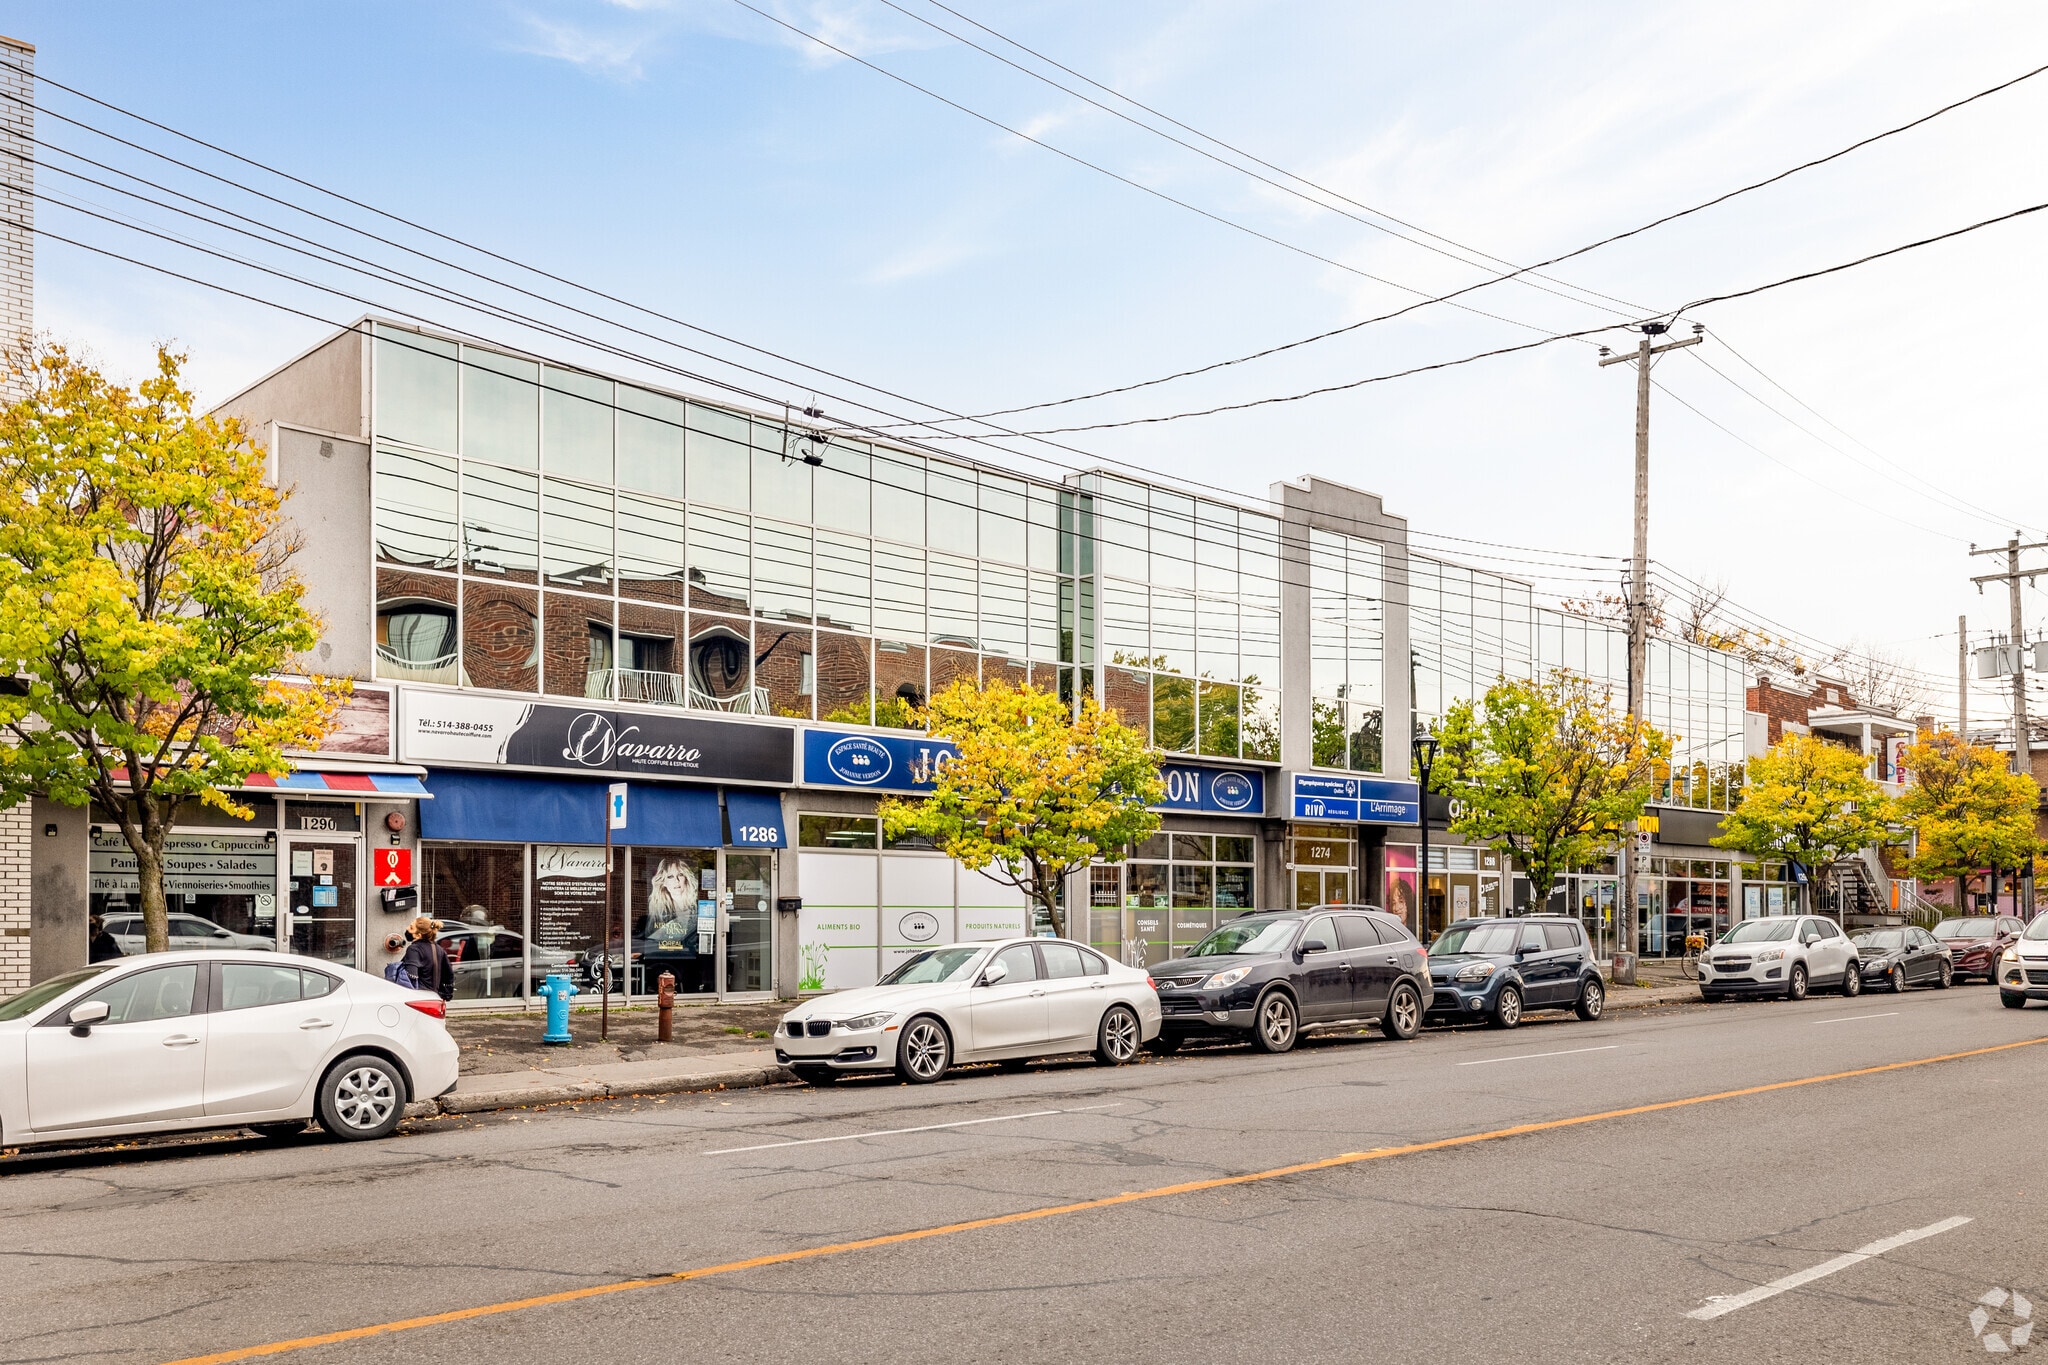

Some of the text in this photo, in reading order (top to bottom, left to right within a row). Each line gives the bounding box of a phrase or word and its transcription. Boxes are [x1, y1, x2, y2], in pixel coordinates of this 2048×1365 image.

[436, 720, 494, 732] 514-388-0455
[418, 729, 492, 738] www.navarrohautecoiffure.com
[562, 724, 702, 762] Navarro
[835, 743, 852, 756] ESPACE
[1298, 779, 1324, 788] Olympiques
[1305, 804, 1324, 816] RIVO
[1370, 802, 1406, 816] L'Arrimage
[303, 817, 336, 831] 1290
[740, 826, 778, 842] 1286
[94, 837, 118, 847] Café
[164, 841, 202, 851] spresso
[211, 840, 270, 851] Cappuccino
[1310, 846, 1331, 858] 1274
[166, 859, 207, 870] Soupes
[216, 860, 258, 870] Salades
[94, 878, 110, 888] Thé
[112, 879, 118, 888] à
[120, 878, 128, 889] la
[168, 880, 224, 890] Viennoiseries
[228, 880, 270, 890] Smoothies
